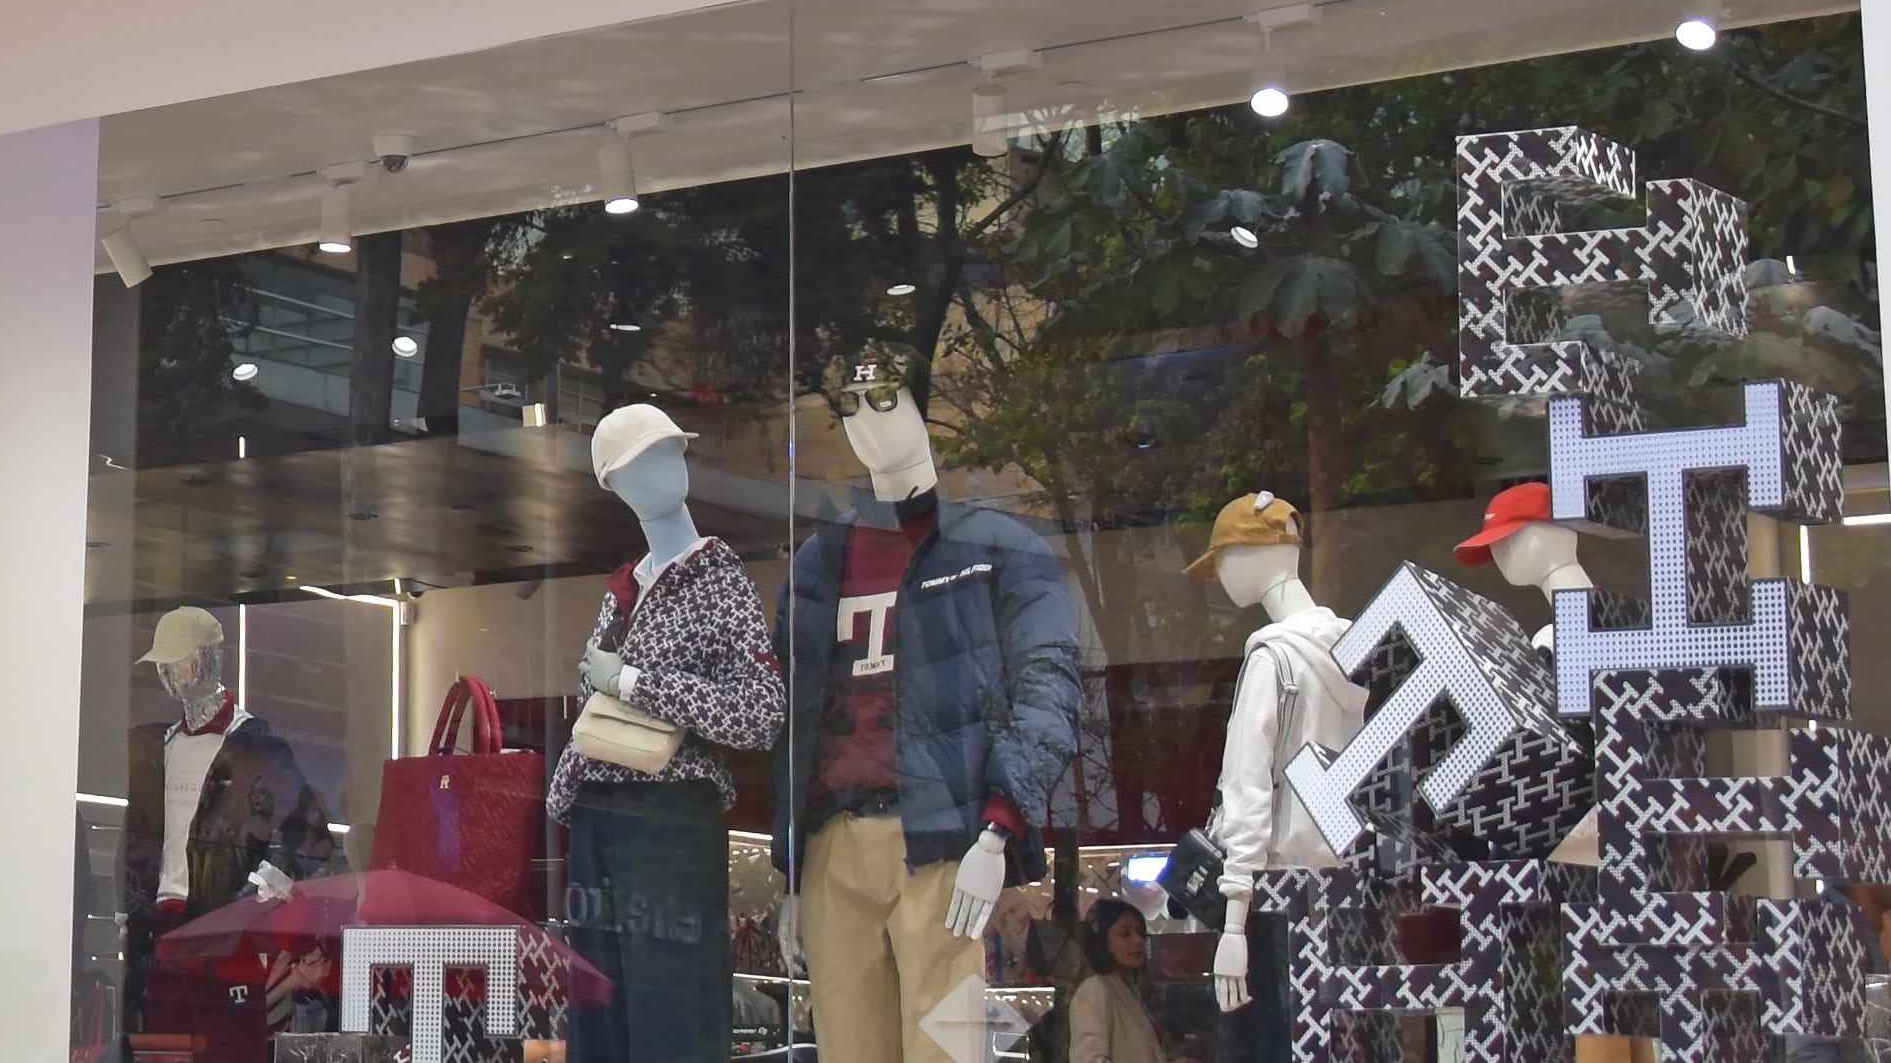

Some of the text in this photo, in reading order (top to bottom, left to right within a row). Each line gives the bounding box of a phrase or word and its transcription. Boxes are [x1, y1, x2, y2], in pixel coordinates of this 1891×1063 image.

[853, 364, 877, 381] H
[837, 591, 898, 676] T
[229, 985, 248, 1004] T
